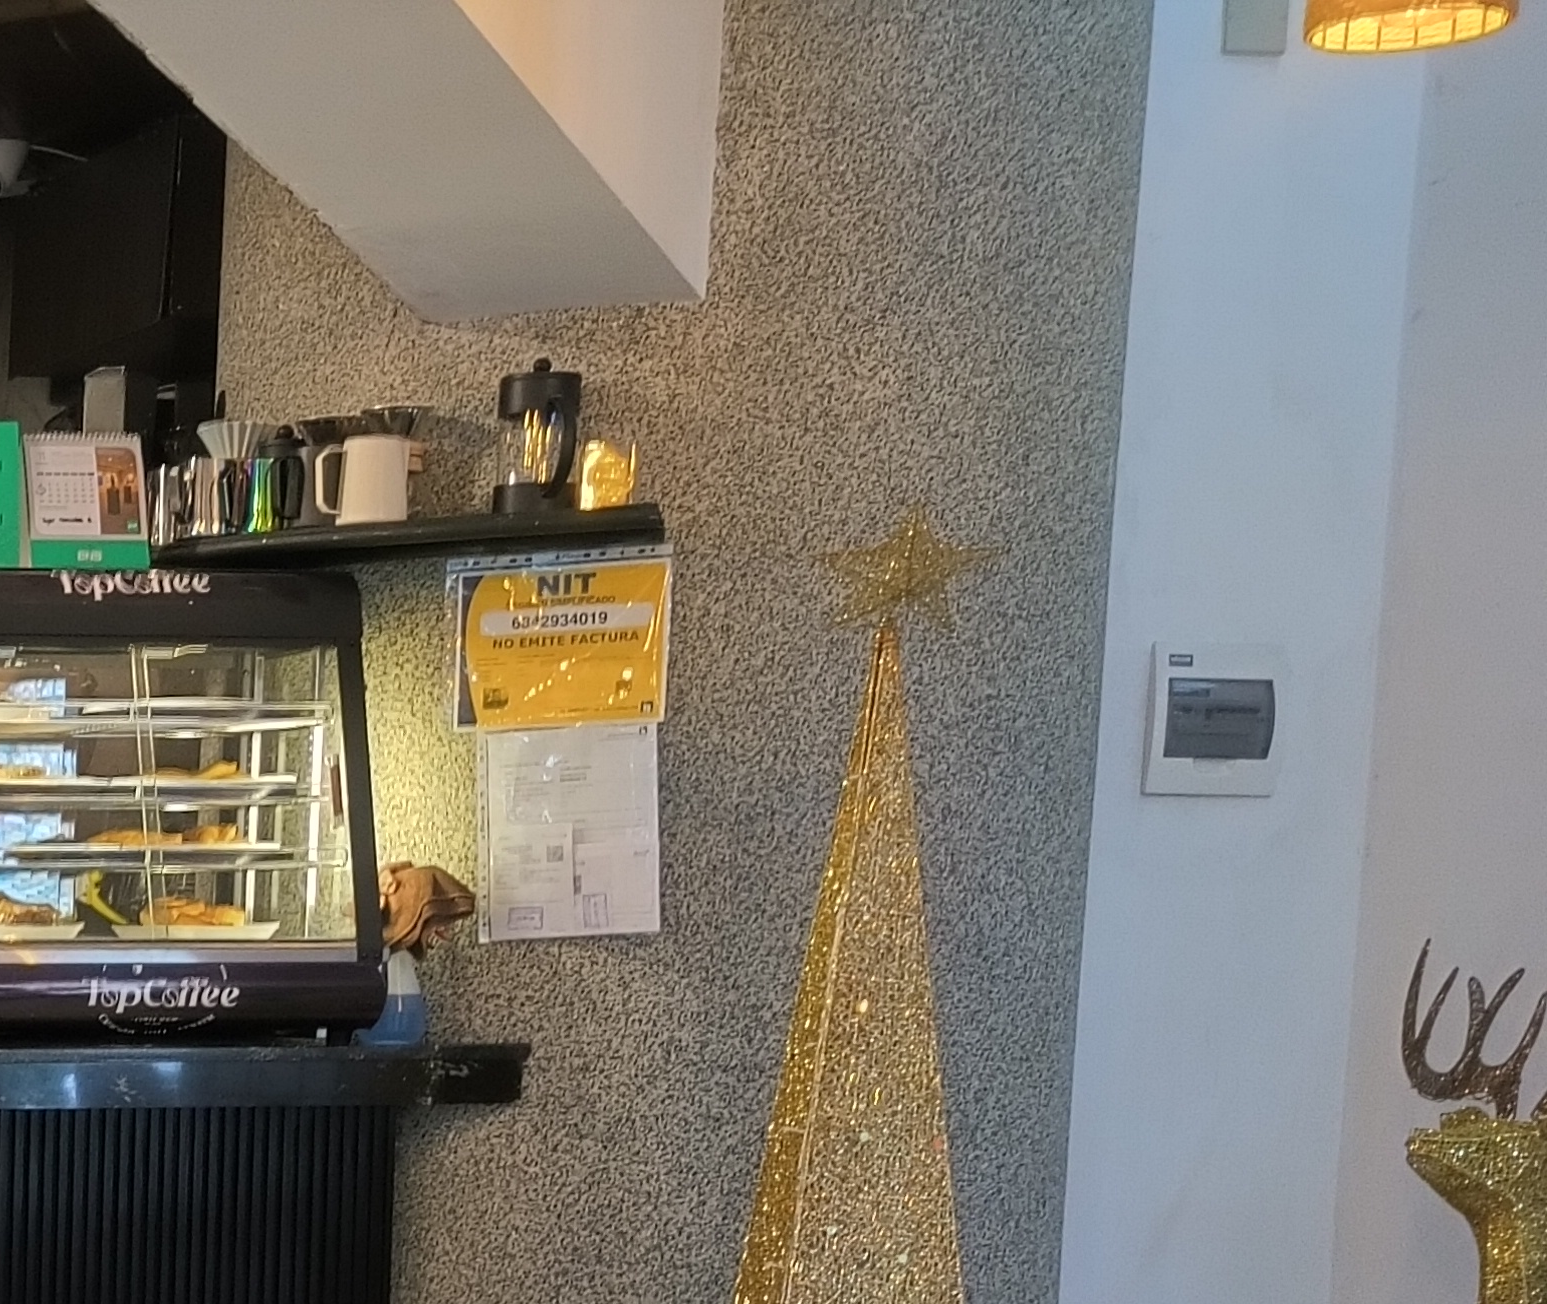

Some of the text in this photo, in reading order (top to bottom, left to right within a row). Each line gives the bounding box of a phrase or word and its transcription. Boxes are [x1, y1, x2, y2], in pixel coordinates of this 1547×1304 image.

[536, 572, 597, 597] NIT
[491, 630, 640, 650] NO EMITE FACTURA
[81, 975, 241, 1015] TopCoffee
